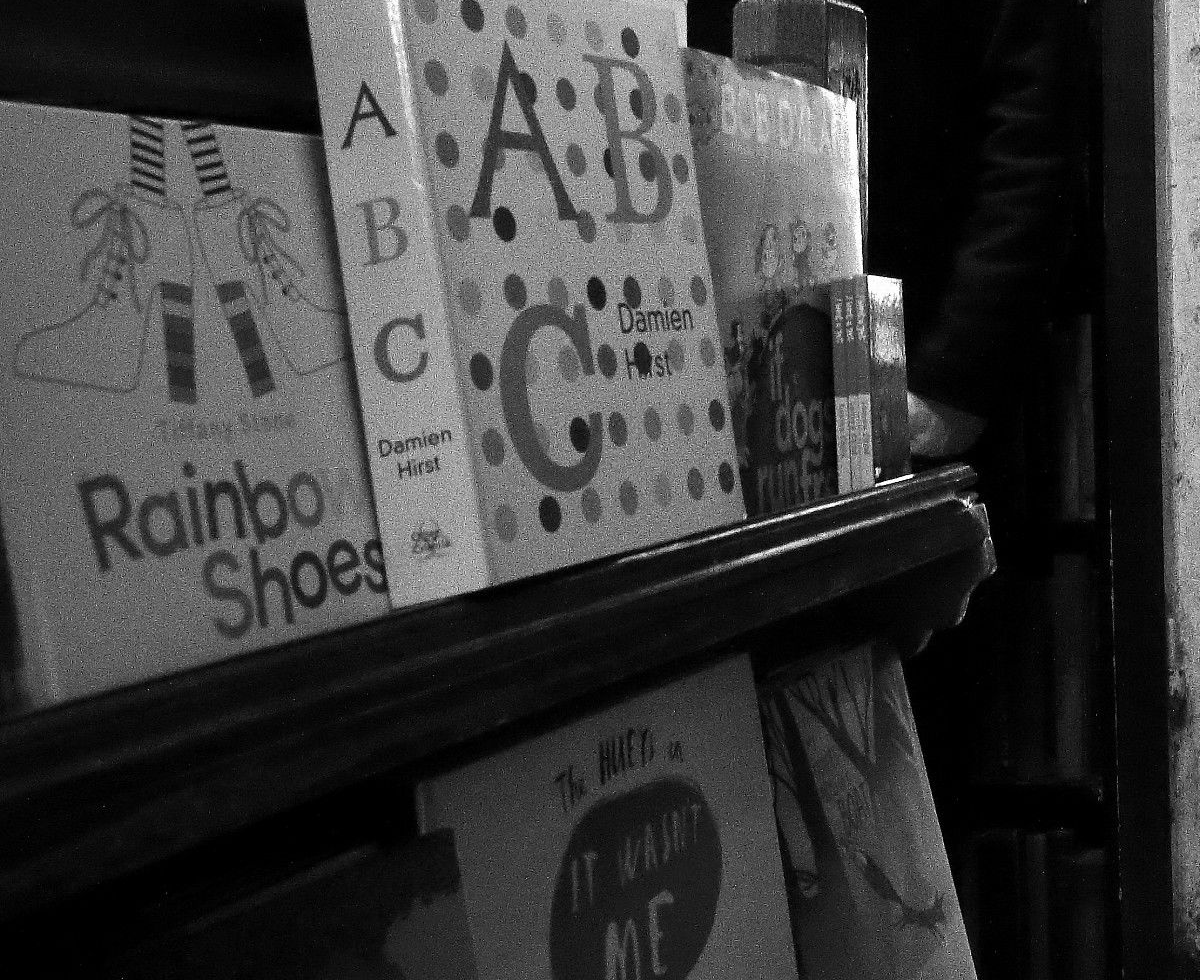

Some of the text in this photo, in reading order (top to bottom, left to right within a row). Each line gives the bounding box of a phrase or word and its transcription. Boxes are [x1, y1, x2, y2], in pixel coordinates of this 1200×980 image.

[341, 80, 397, 150] A
[470, 40, 673, 223] A B
[356, 195, 410, 267] B
[373, 314, 429, 384] C
[616, 300, 695, 334] Damien
[502, 304, 602, 493] C
[623, 347, 673, 380] Hst
[378, 426, 453, 458] Damien
[397, 454, 442, 479] Hirst
[204, 537, 390, 639] Shoes
[570, 850, 599, 916] IT
[604, 888, 676, 980] ME
